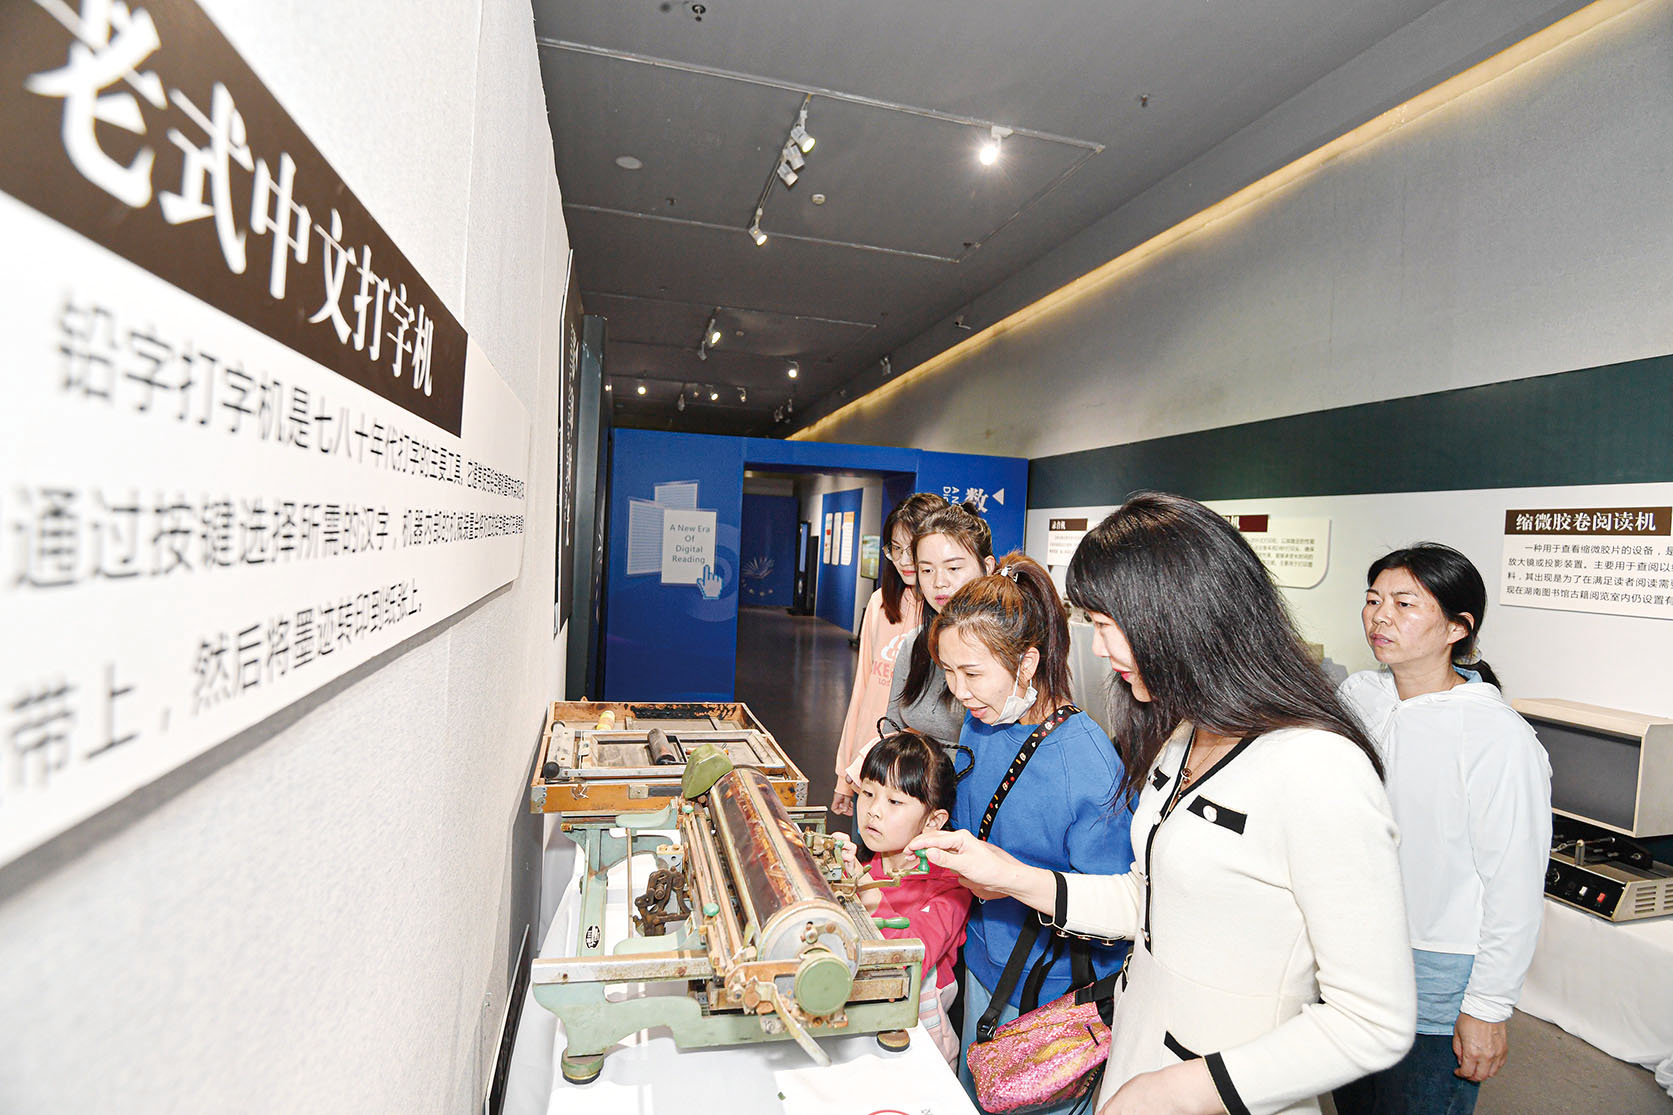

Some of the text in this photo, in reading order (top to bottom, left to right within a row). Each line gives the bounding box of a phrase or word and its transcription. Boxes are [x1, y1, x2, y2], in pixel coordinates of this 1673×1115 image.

[24, 0, 434, 396] 老式中文打字机
[1515, 511, 1657, 532] 缩微胶卷阅读机
[670, 524, 711, 533] A New Era
[684, 534, 695, 543] Of
[675, 544, 704, 554] Digital
[672, 555, 706, 565] Reading
[1507, 557, 1673, 572] 放大镜或投影装置。主要用于查阅以
